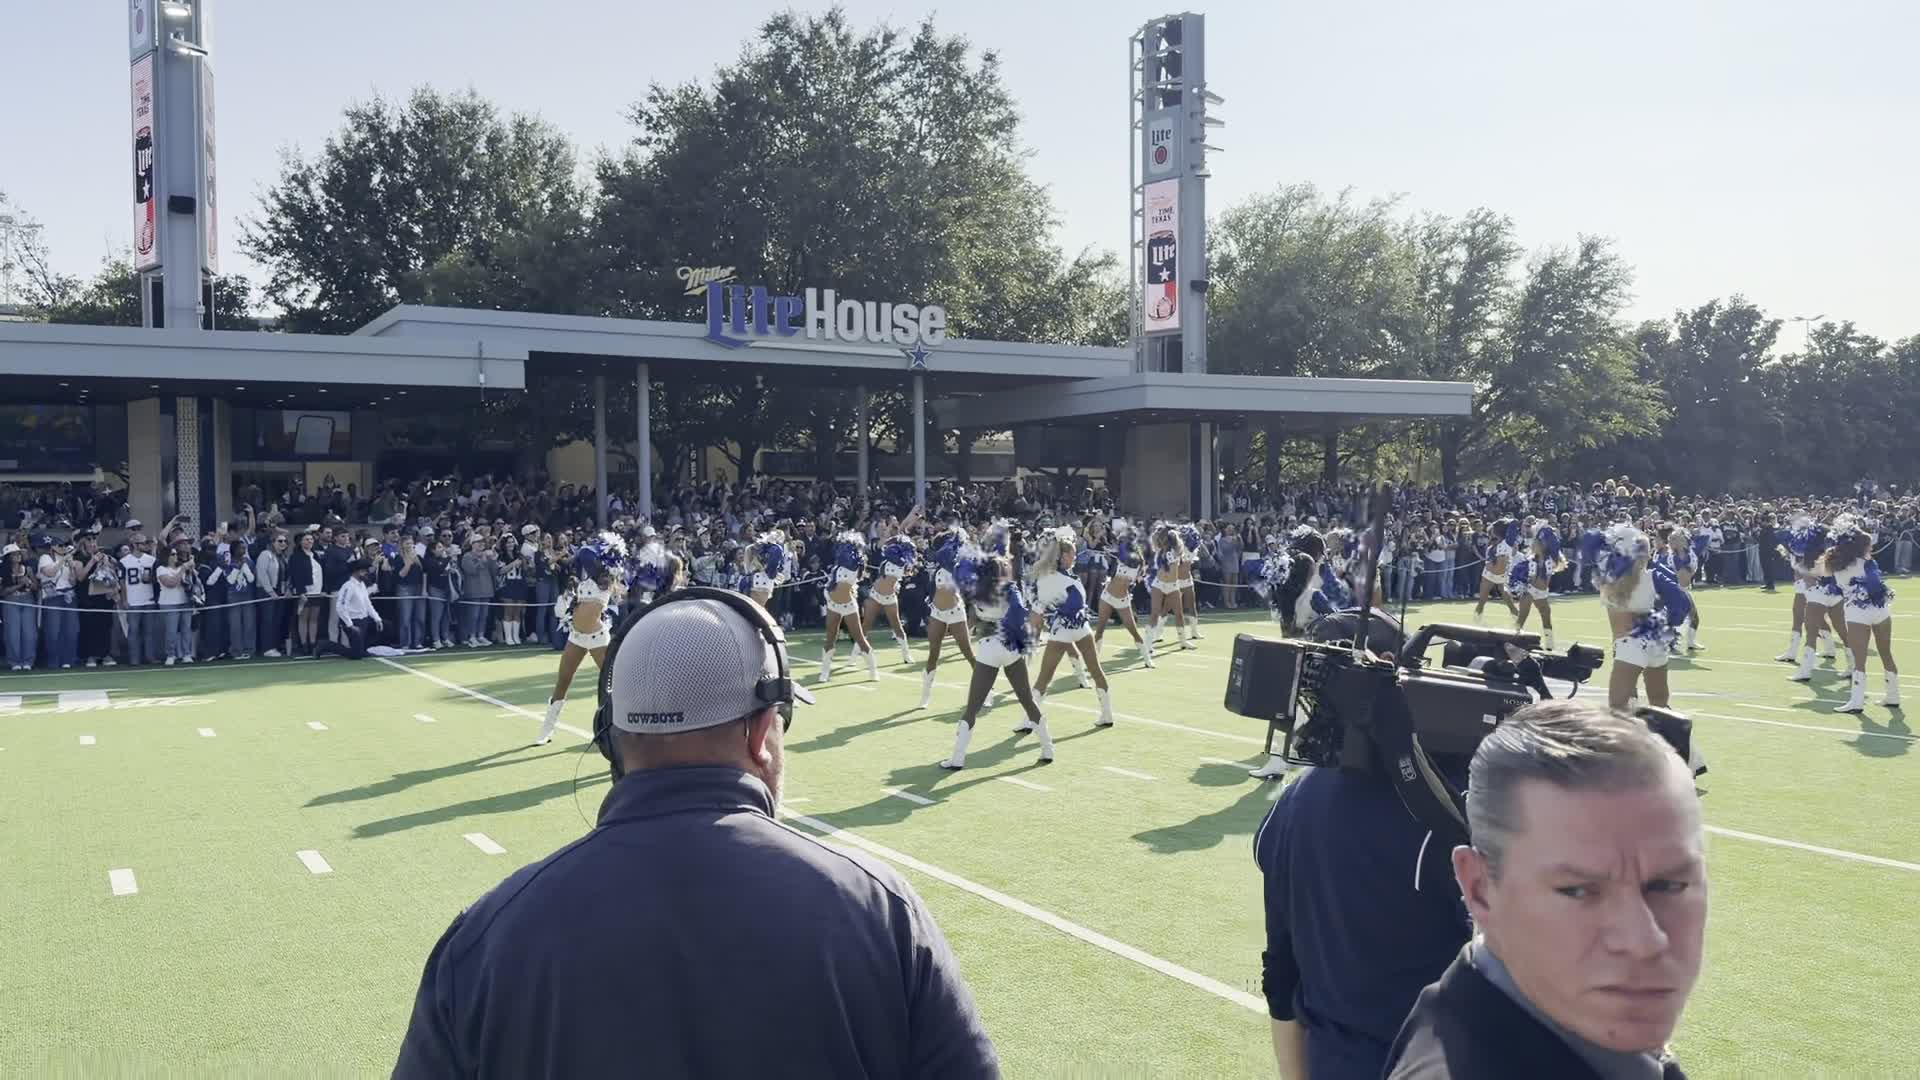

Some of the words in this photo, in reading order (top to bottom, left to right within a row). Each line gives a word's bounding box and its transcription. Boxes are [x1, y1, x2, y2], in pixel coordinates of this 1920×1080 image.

[1152, 127, 1172, 146] Lite
[1152, 215, 1171, 224] TEXAS
[1152, 243, 1176, 266] Lite
[677, 265, 737, 293] Miller
[627, 711, 684, 724] COWBOYS
